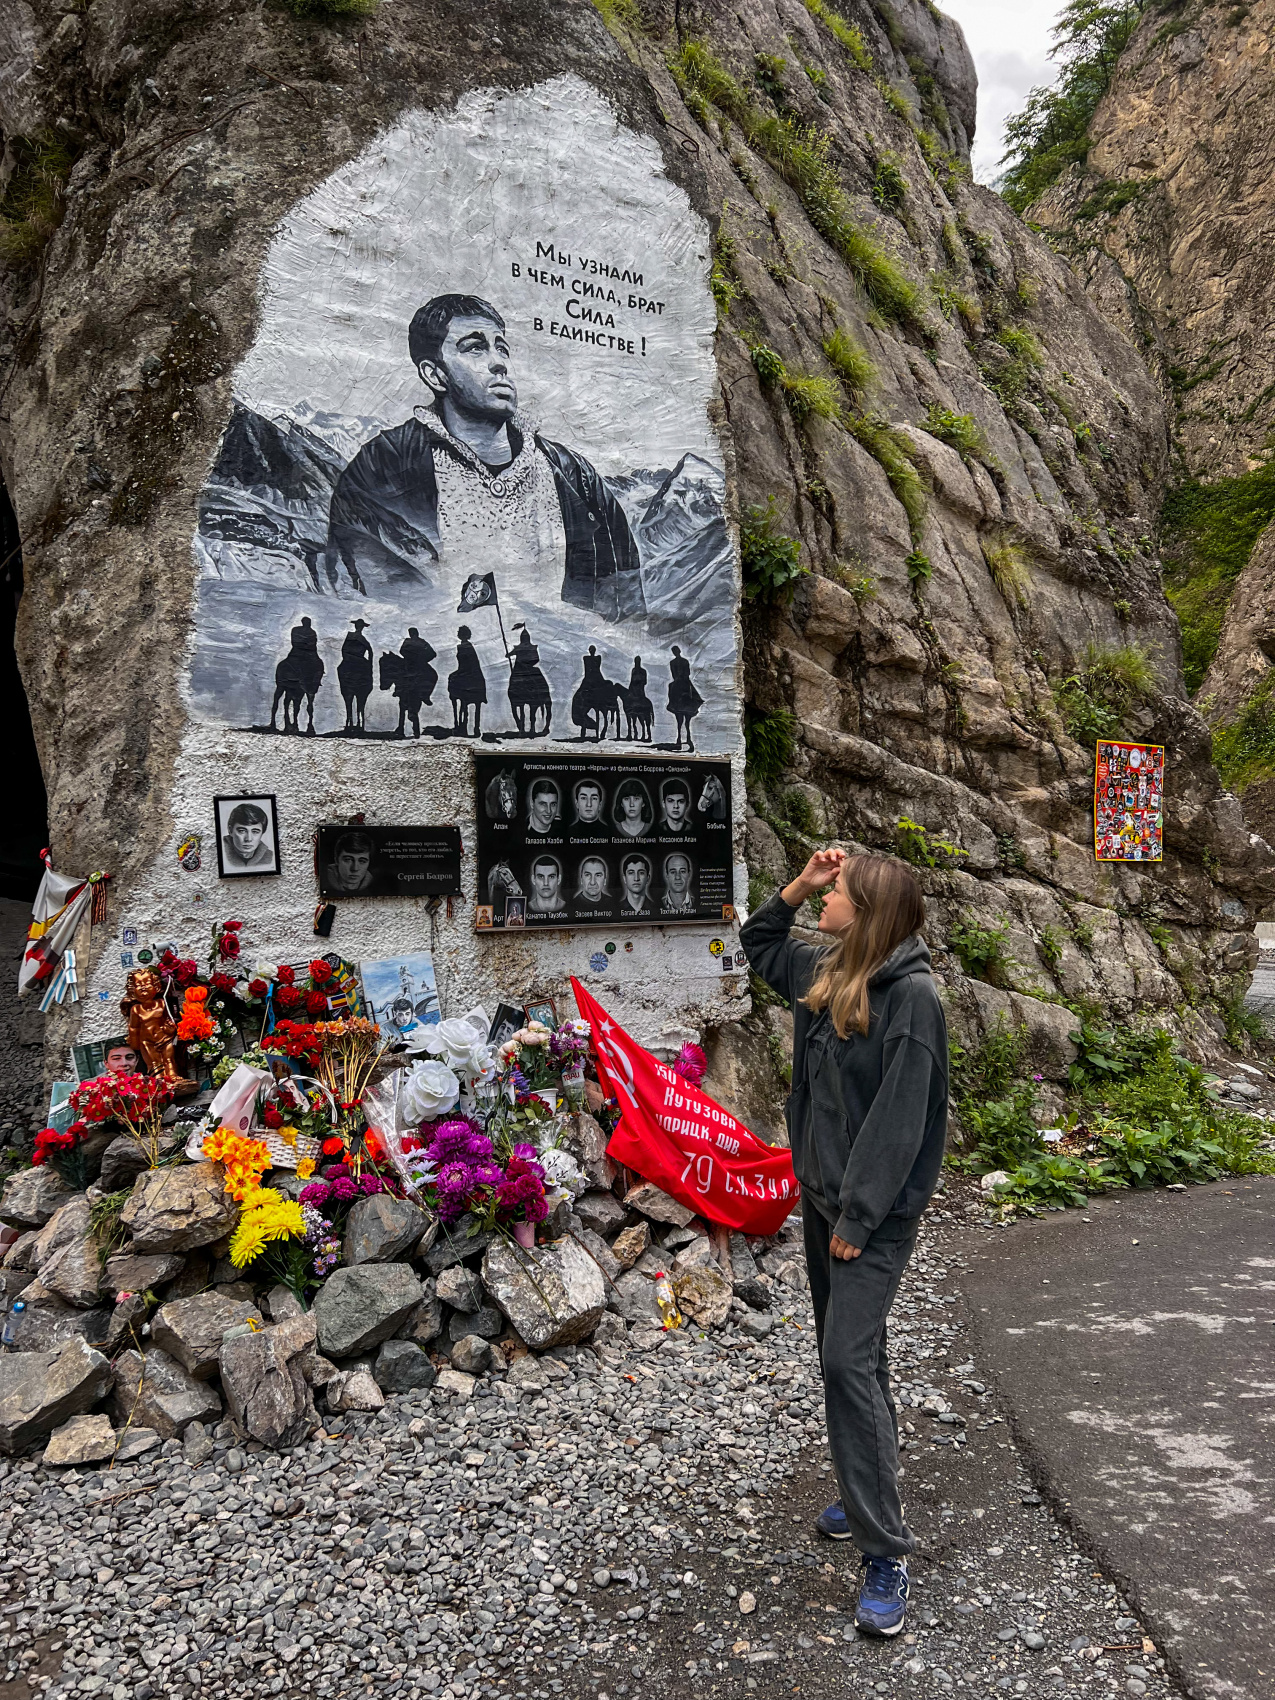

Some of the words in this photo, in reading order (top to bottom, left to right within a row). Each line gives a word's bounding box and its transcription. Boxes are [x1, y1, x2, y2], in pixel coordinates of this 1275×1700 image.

[523, 762, 546, 771] Артисты
[569, 764, 586, 772] театра
[397, 872, 425, 882] Сергей
[426, 872, 453, 882] Бодров
[593, 910, 613, 918] Виктор
[680, 1150, 713, 1194] 79
